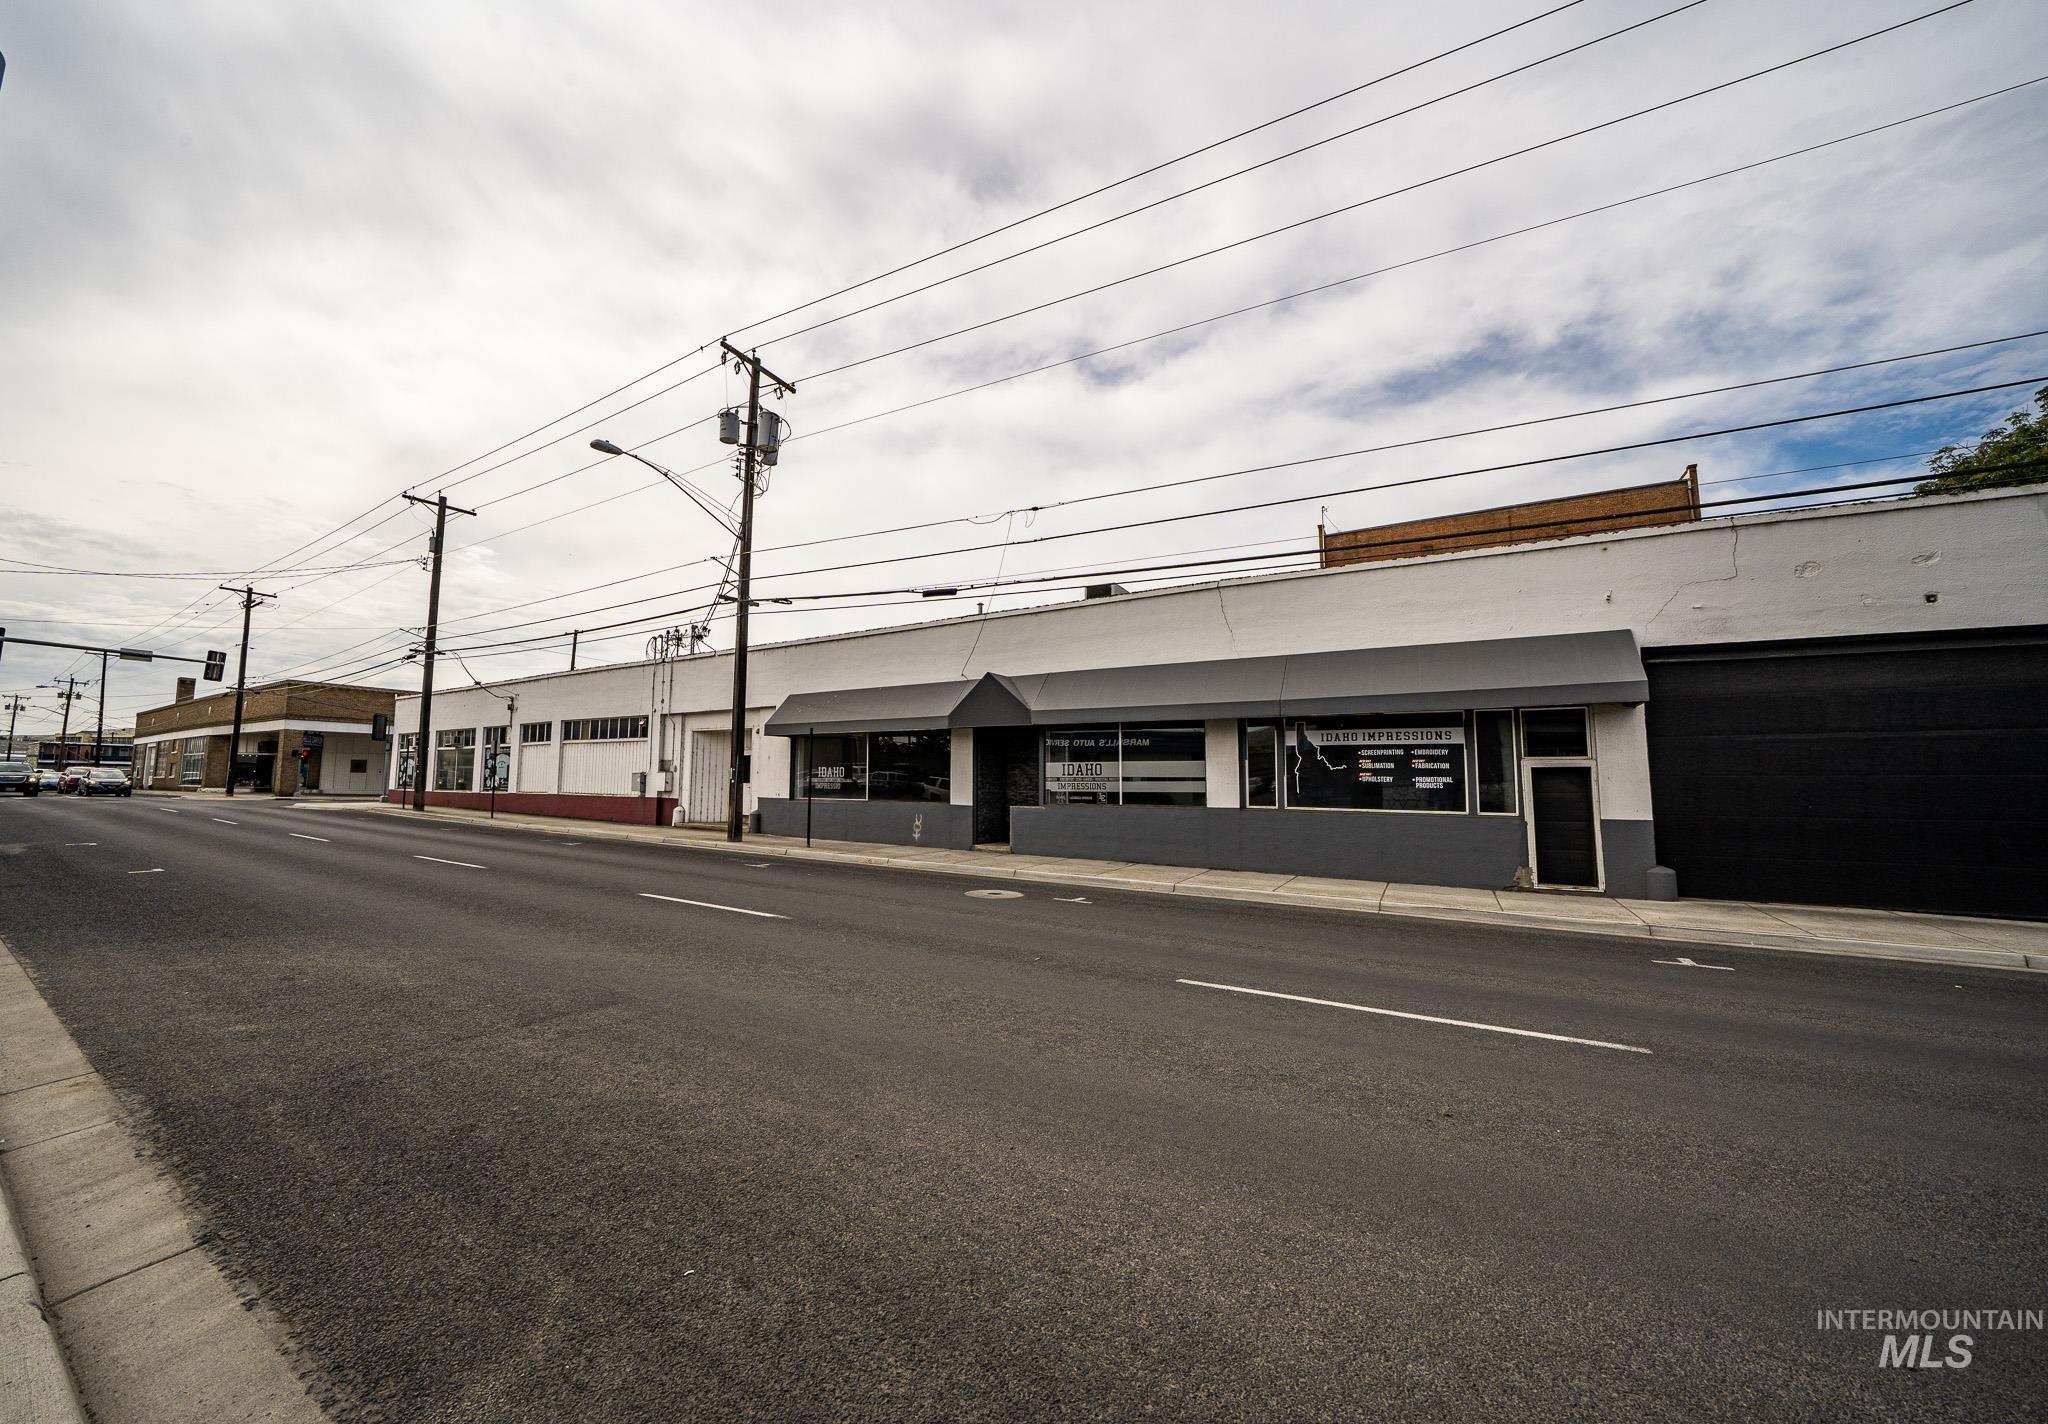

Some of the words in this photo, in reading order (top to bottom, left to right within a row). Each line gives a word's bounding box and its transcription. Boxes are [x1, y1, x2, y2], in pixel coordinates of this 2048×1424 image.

[1320, 732, 1358, 743] IDAHO
[1362, 730, 1452, 742] IMPRESSIONS
[1361, 748, 1404, 756] SCREENPRINTING
[817, 766, 845, 778] IDAHO
[1061, 763, 1103, 777] IDAHO
[1057, 782, 1107, 791] IMPRESSIONS
